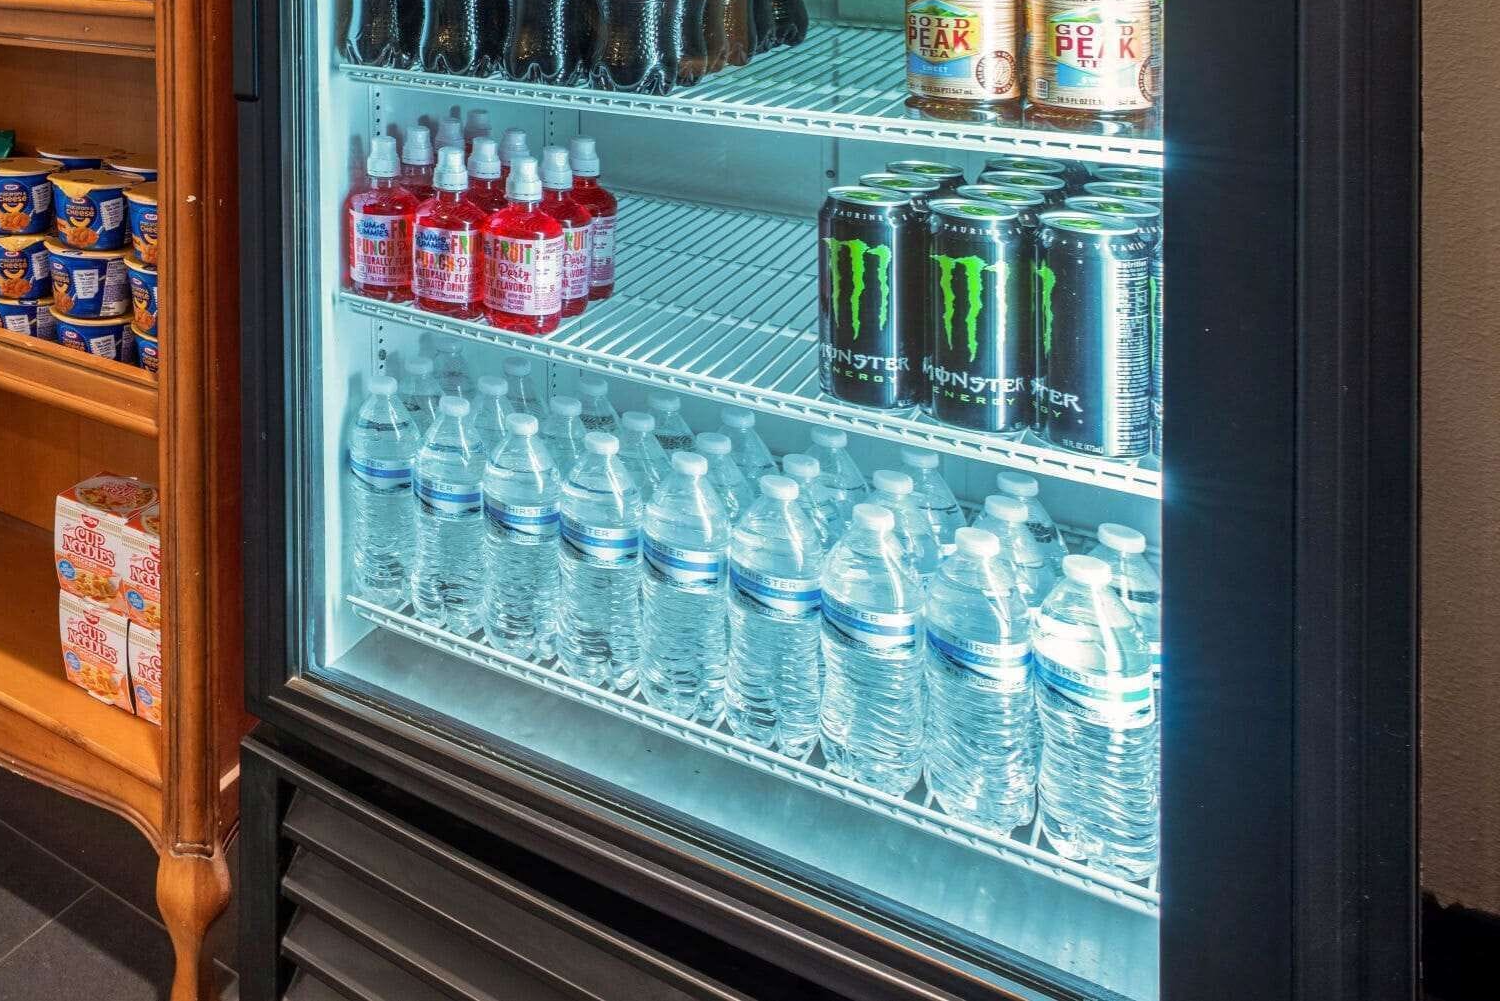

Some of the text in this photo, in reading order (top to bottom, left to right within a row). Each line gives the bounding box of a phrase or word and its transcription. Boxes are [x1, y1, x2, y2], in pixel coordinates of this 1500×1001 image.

[908, 14, 970, 29] GOLD
[1055, 24, 1134, 36] GOD
[908, 26, 972, 51] PEAK
[920, 48, 949, 58] TEA
[499, 263, 530, 281] Party
[75, 525, 105, 547] CUP
[62, 534, 116, 568] NOODLES
[78, 620, 107, 642] CUP
[67, 627, 117, 664] NOODLES
[953, 637, 994, 655] THIRS
[1045, 658, 1100, 686] THIRSTE
